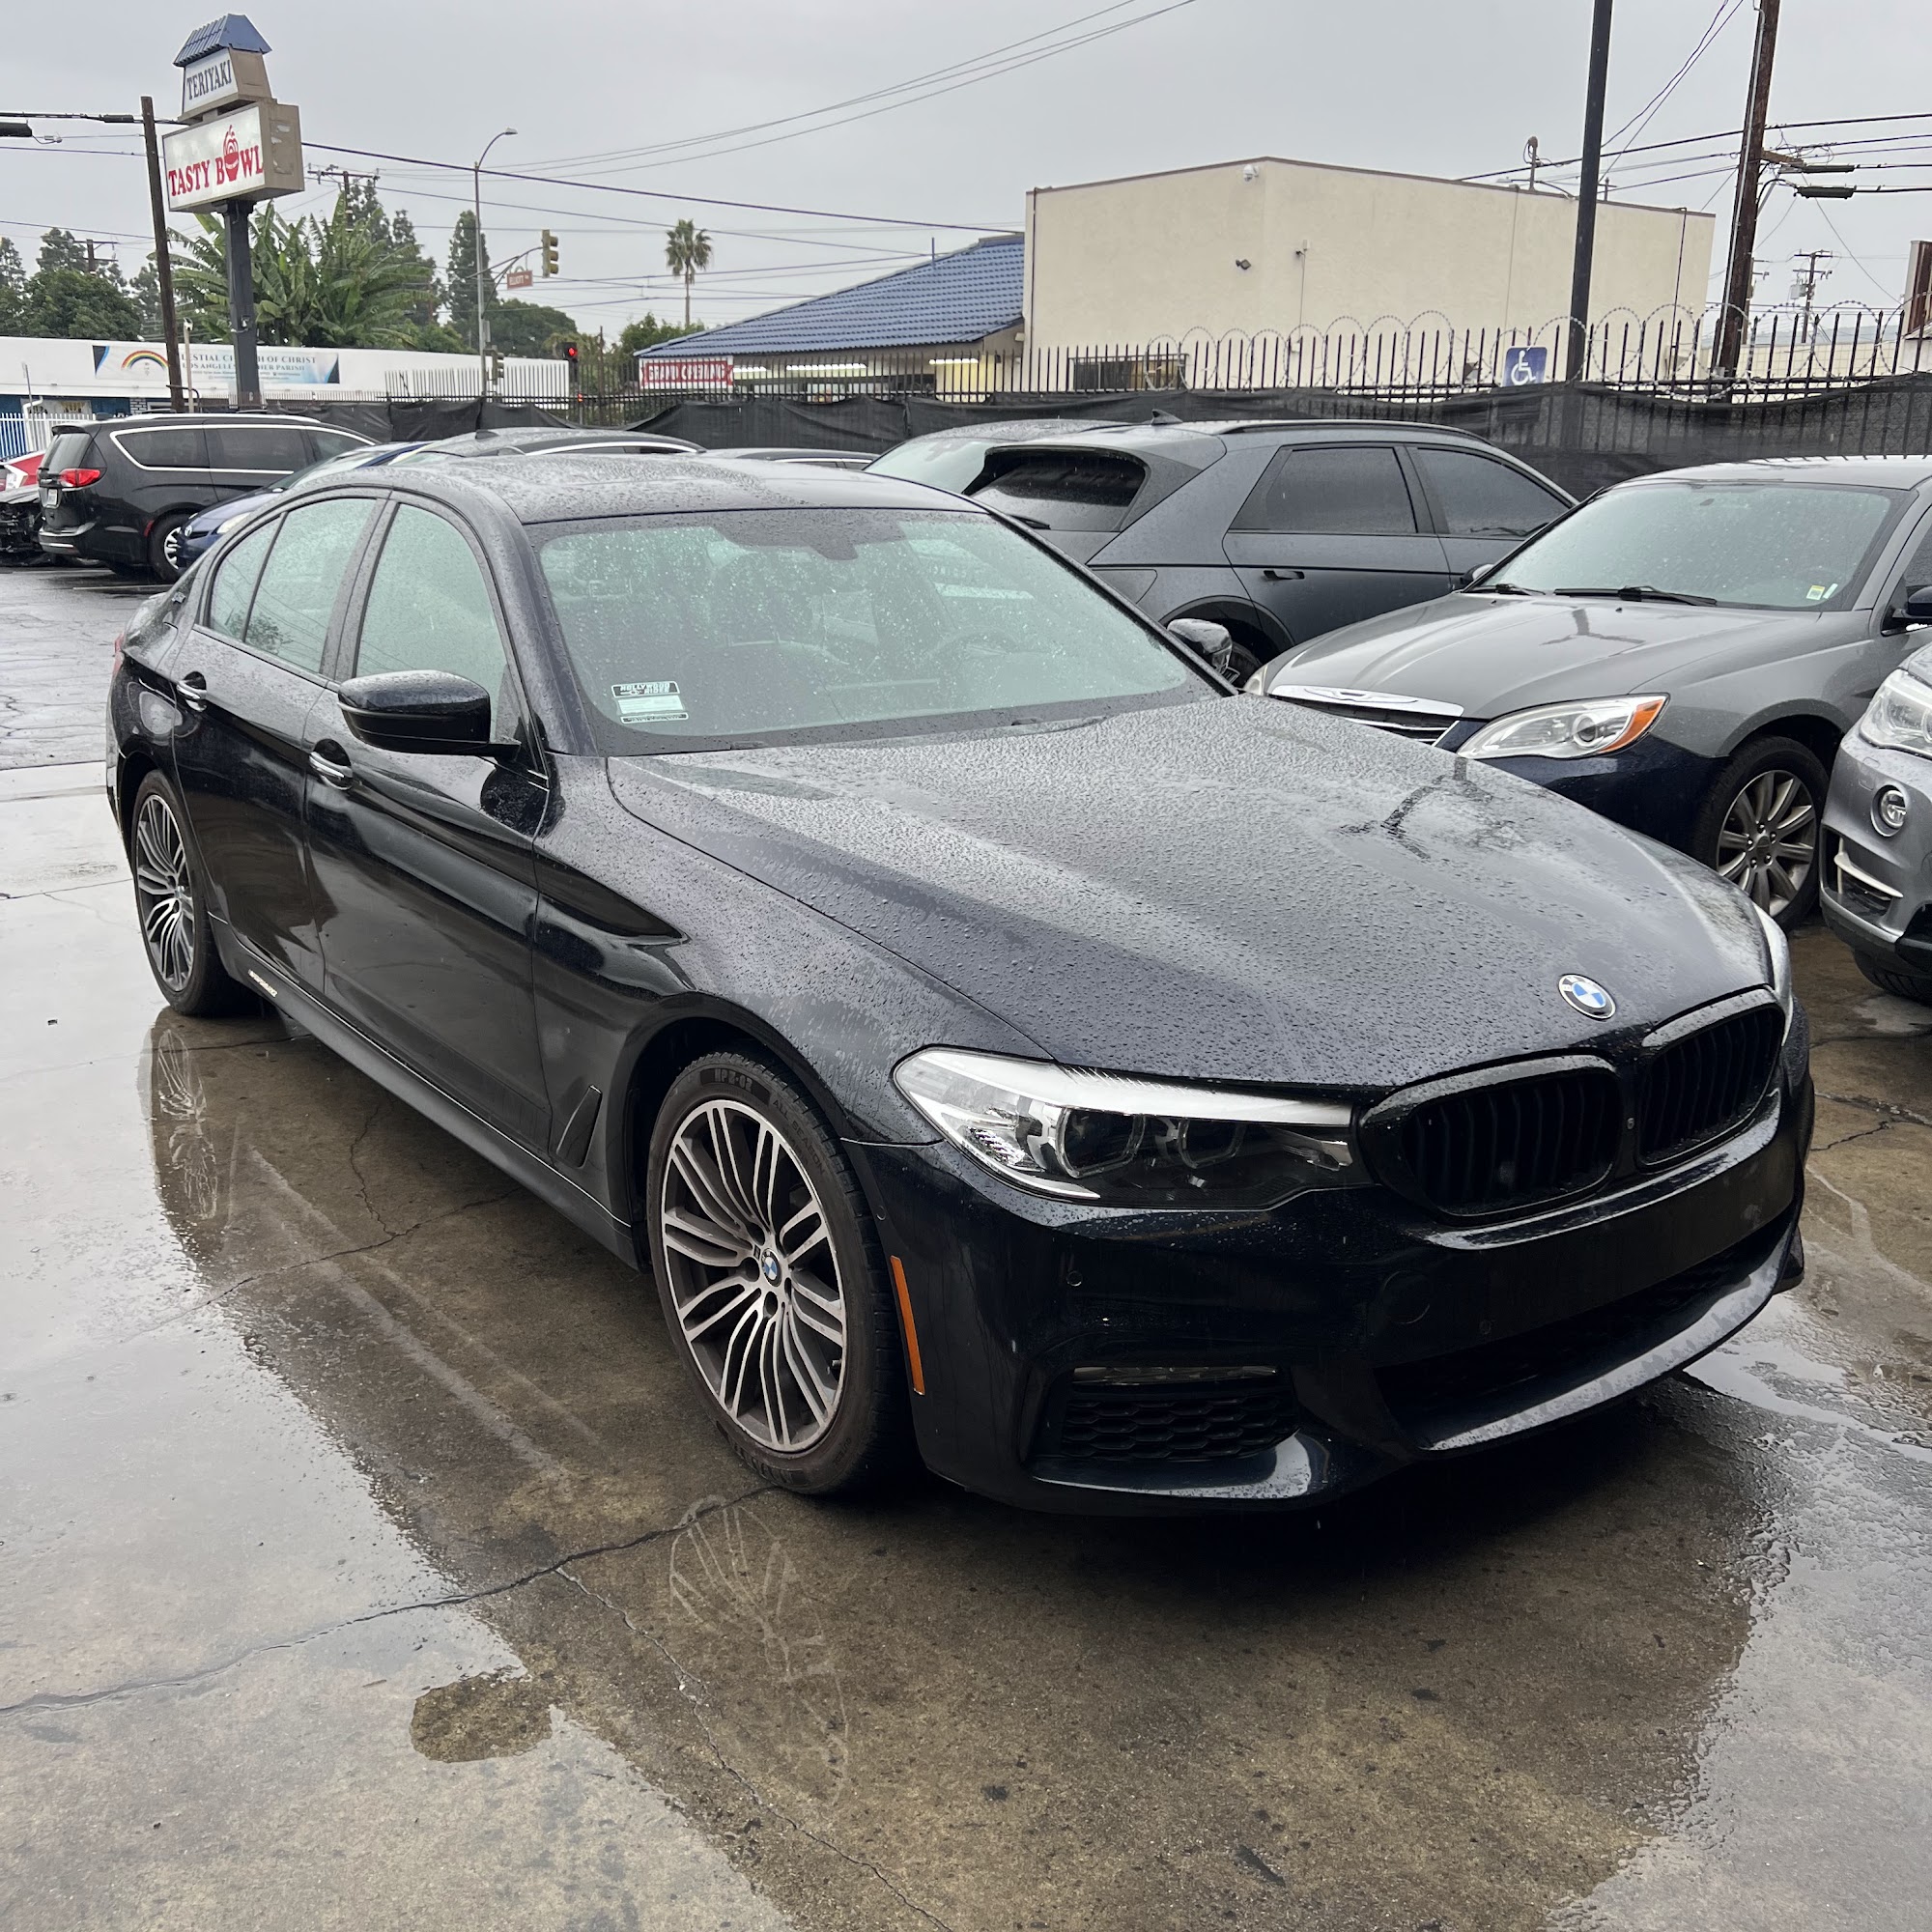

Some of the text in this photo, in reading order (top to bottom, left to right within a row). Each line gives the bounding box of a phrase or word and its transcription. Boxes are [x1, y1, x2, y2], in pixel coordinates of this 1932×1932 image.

[186, 59, 232, 100] TERIYAKI
[168, 159, 211, 197] TASTY
[281, 355, 317, 364] CHRIST
[620, 682, 670, 692] HOLLYWOOD
[792, 1121, 825, 1176] SEASON
